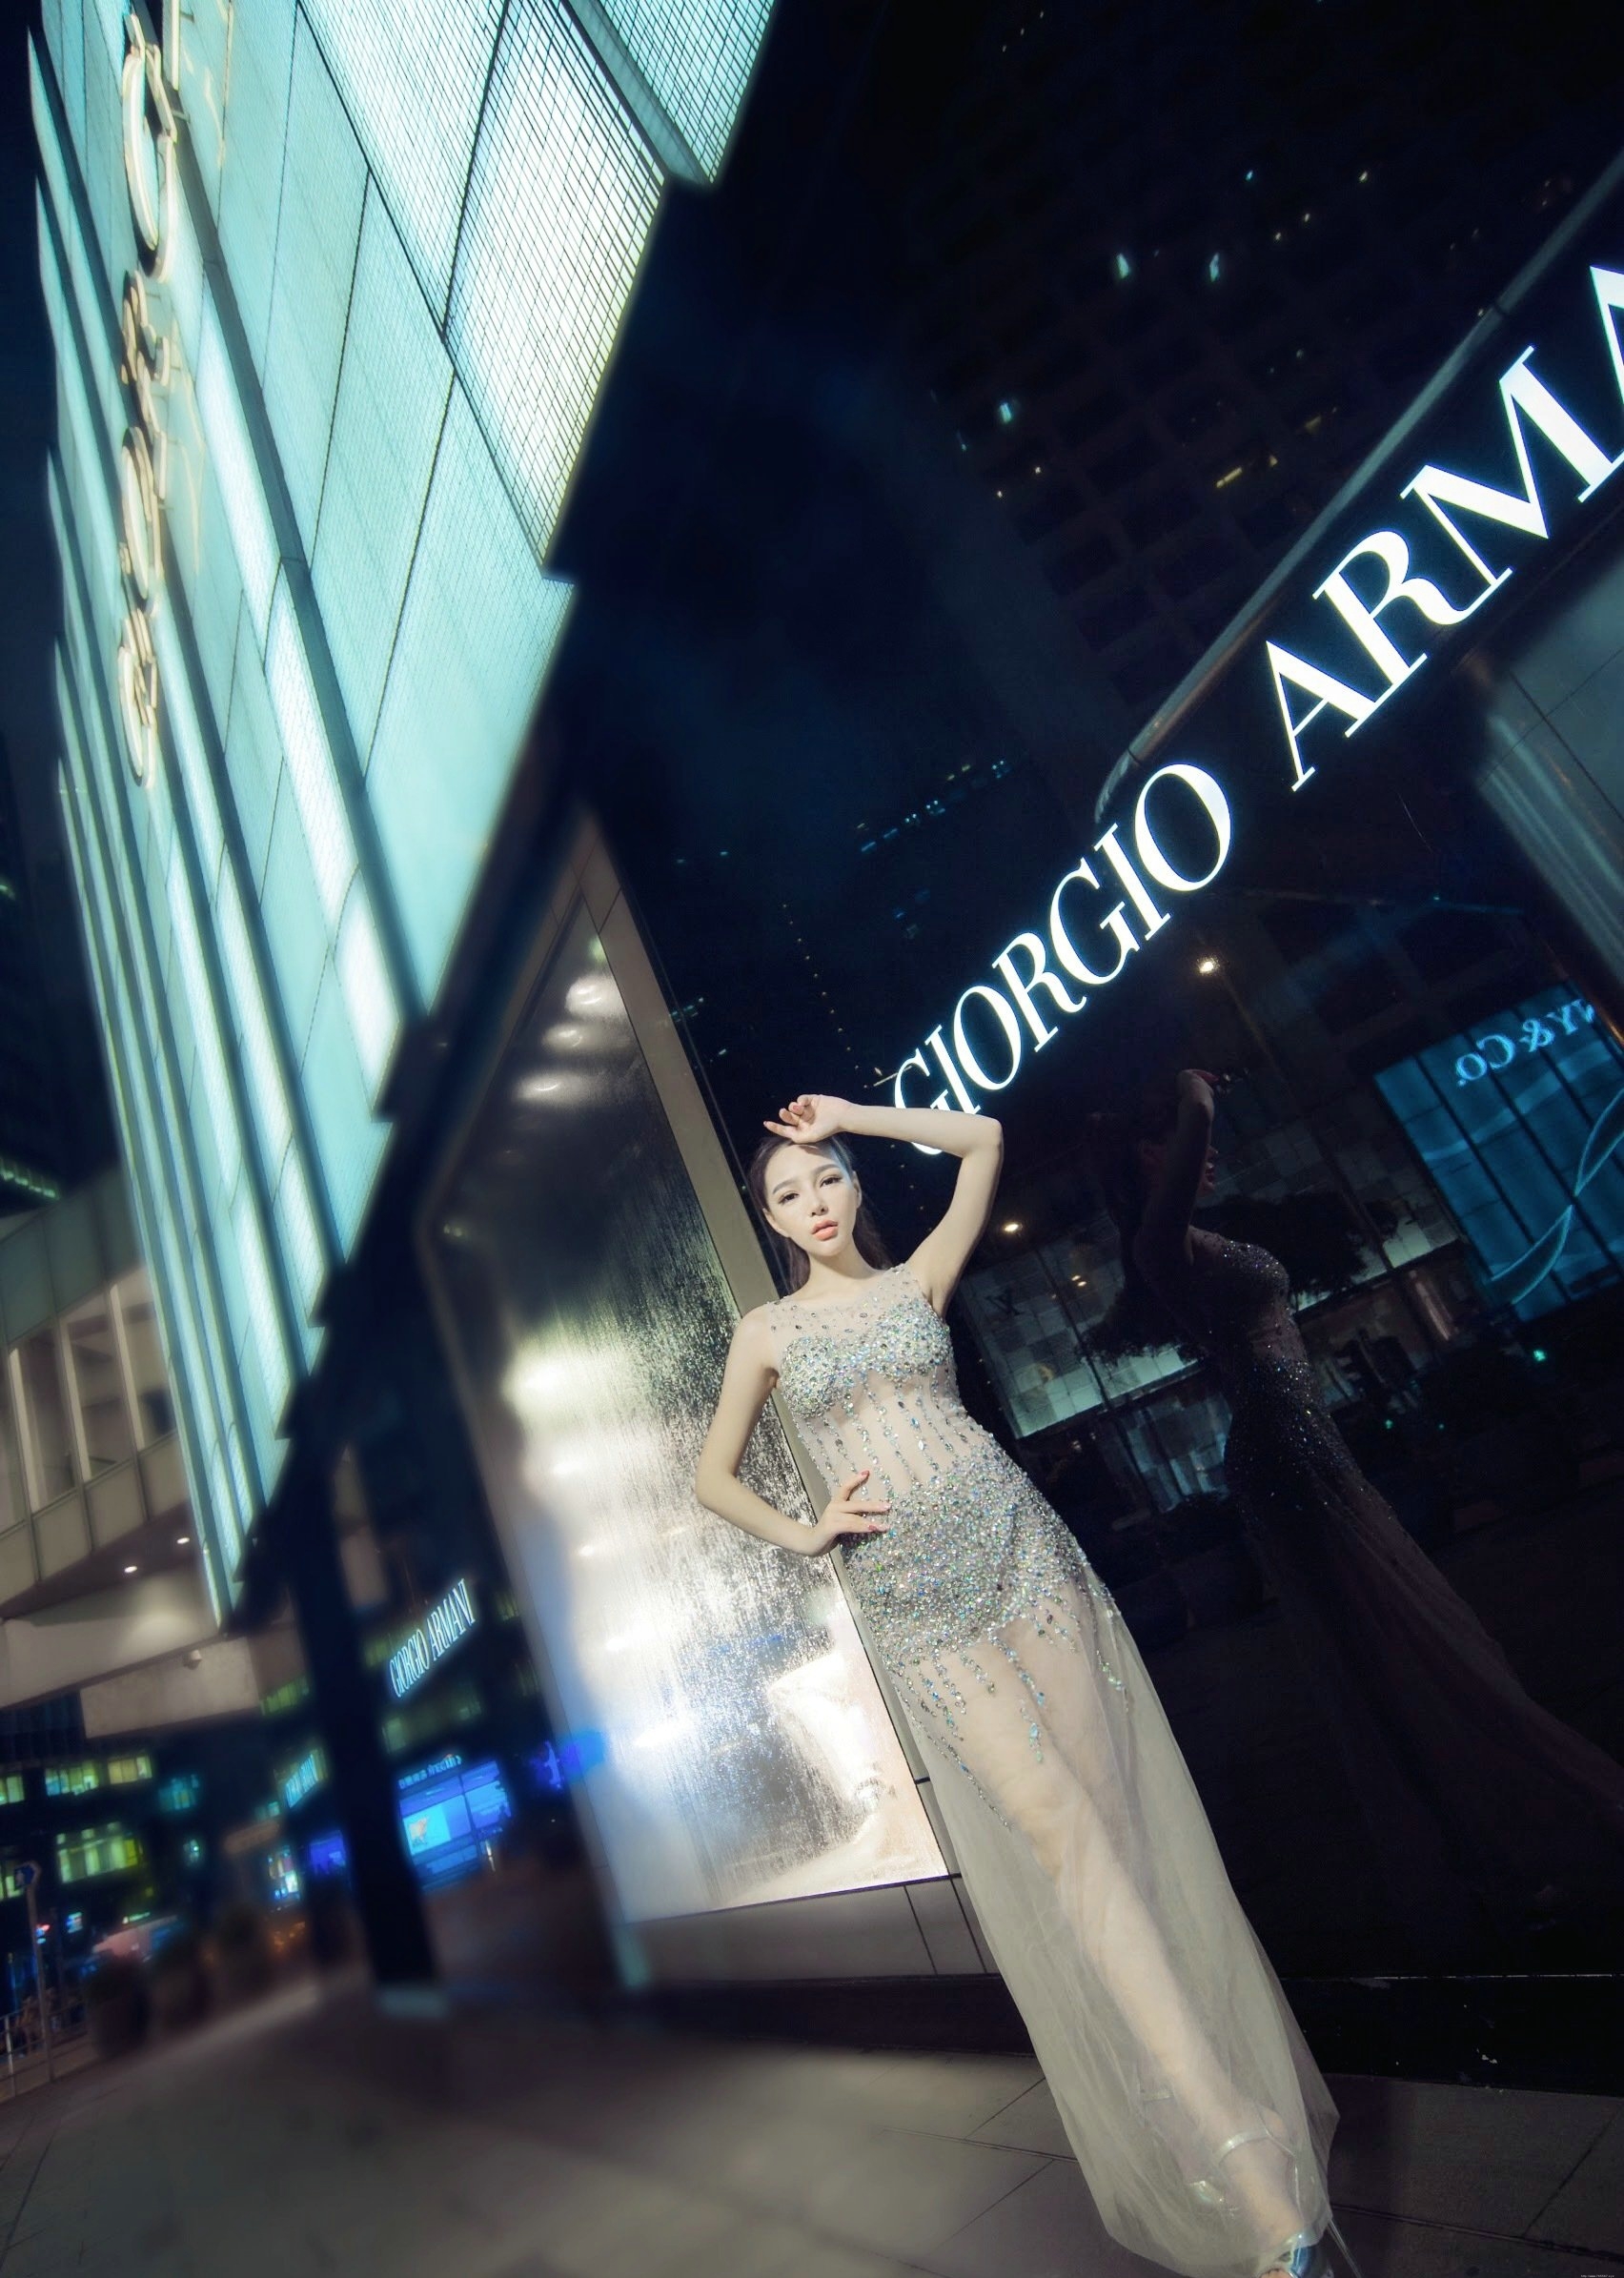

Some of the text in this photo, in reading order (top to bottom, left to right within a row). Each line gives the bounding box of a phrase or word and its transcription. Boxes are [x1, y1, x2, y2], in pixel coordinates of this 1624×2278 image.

[893, 266, 1624, 1156] GIORGIO ARM
[389, 1577, 476, 1698] GIORGIO ARMANI
